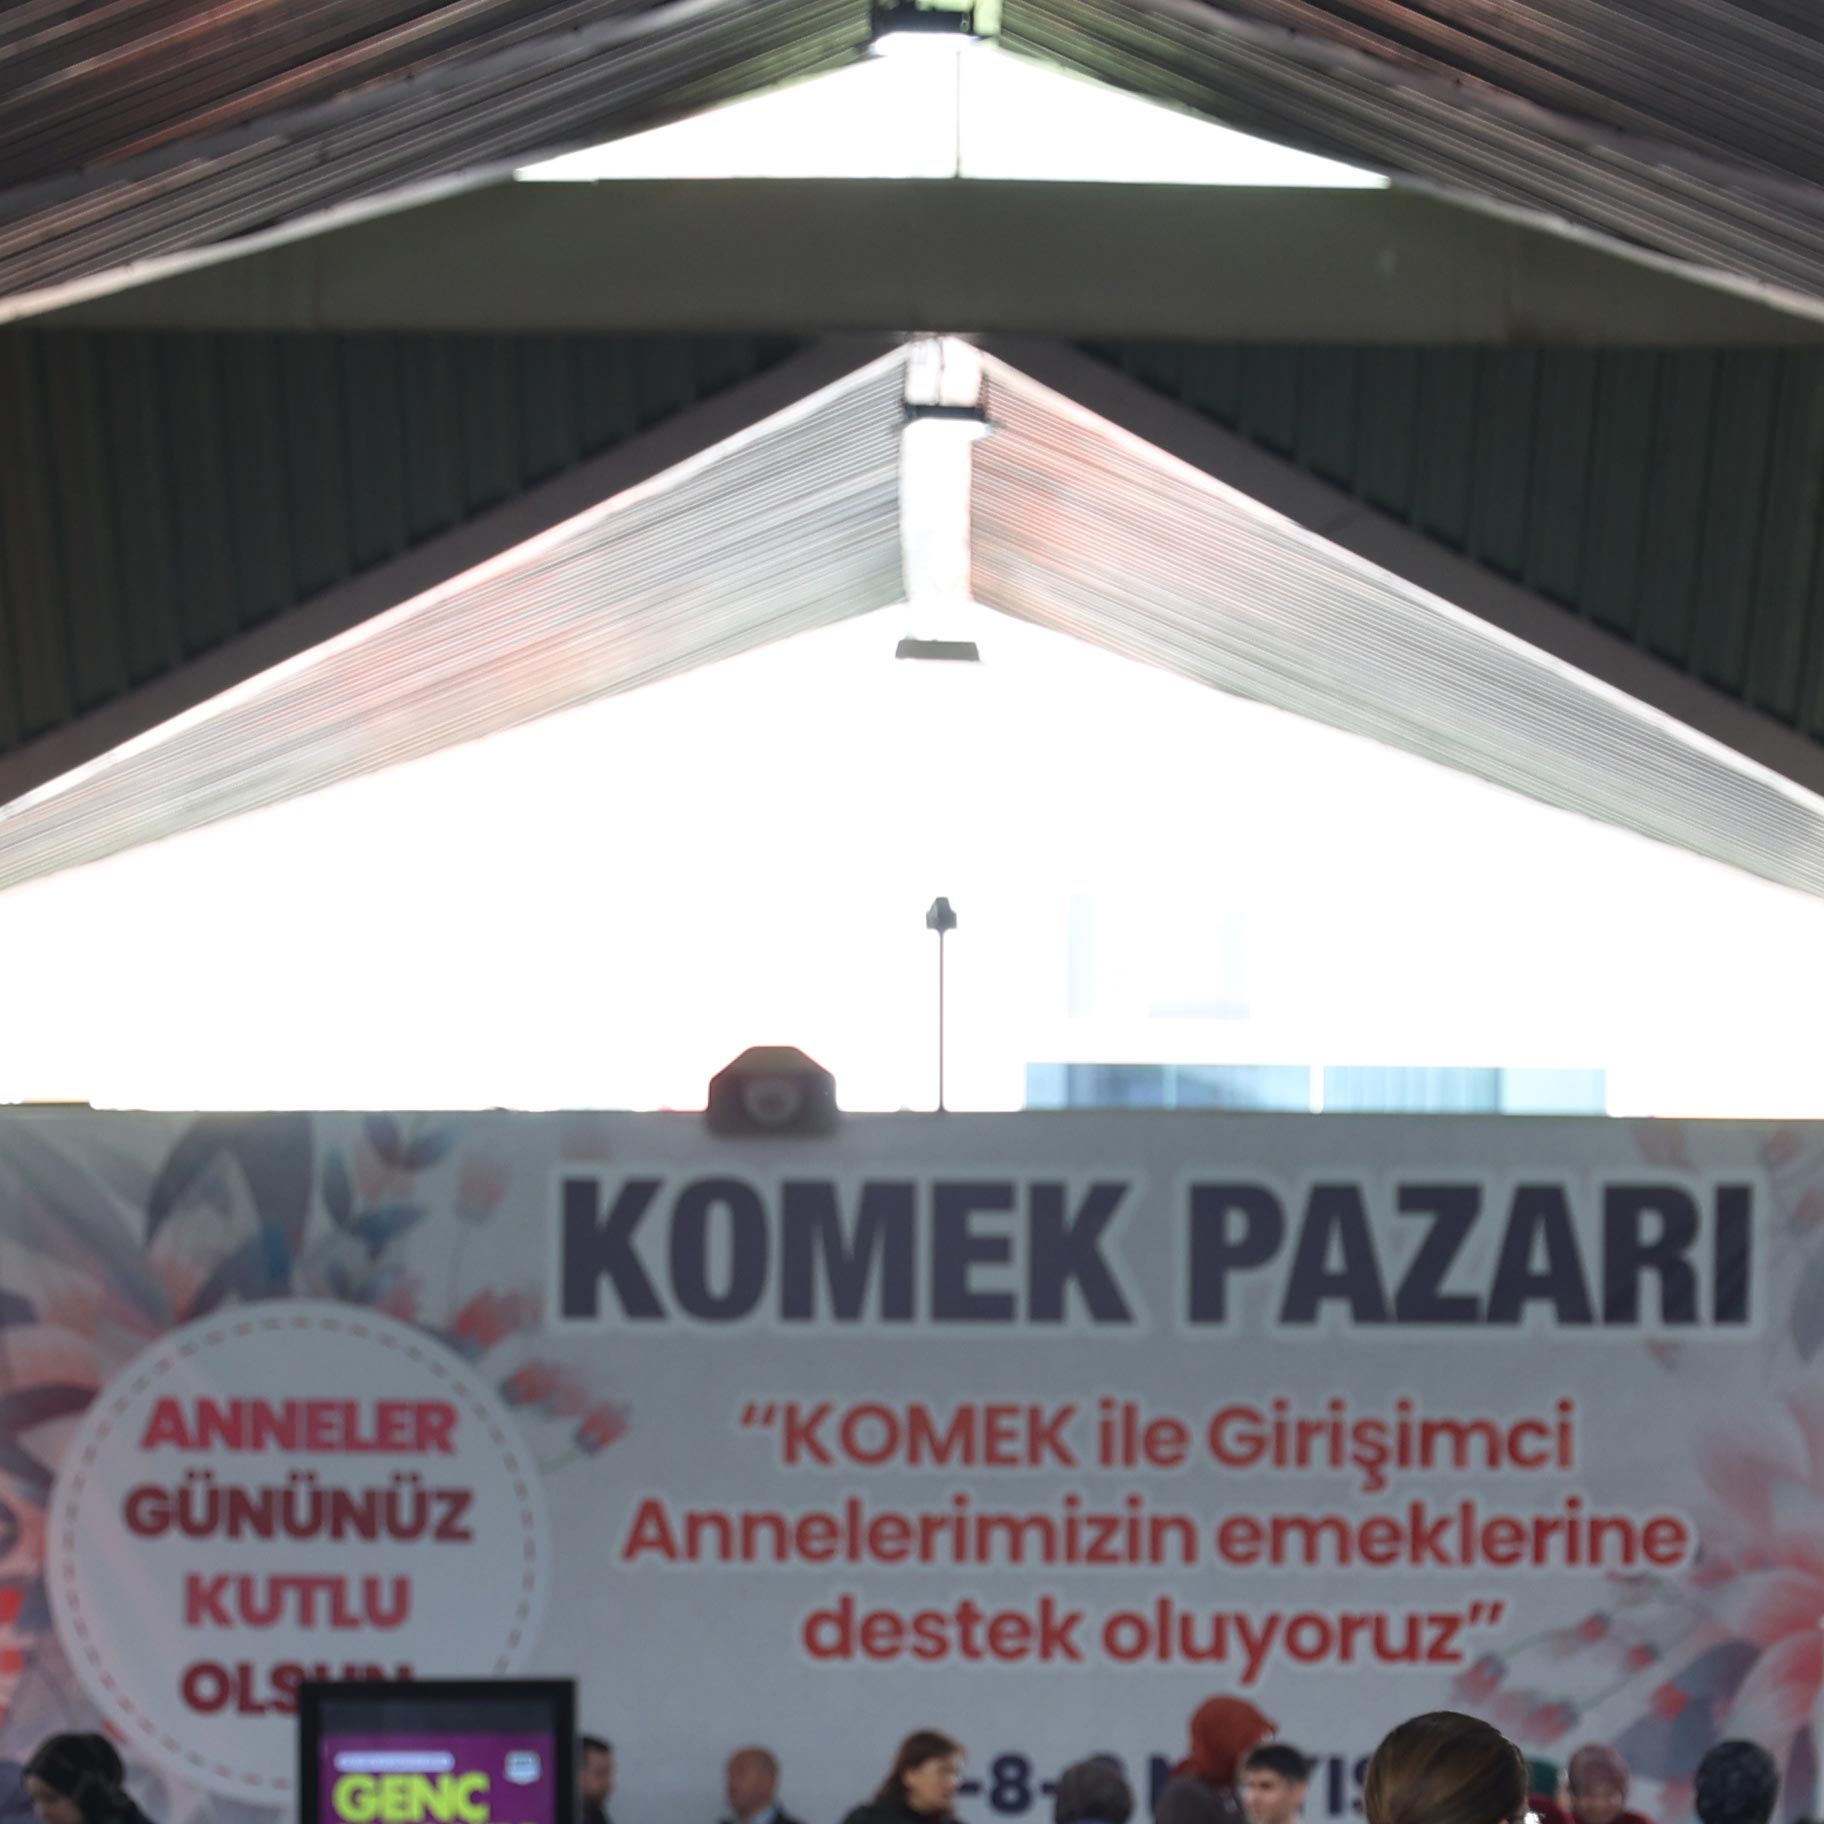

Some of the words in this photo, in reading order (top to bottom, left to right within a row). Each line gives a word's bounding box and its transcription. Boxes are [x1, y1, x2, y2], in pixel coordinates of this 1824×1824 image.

[560, 1176, 1134, 1326] KOMEK
[1187, 1181, 1754, 1327] PAZARI
[139, 1396, 458, 1454] ANNELER
[1096, 1395, 1190, 1468] ile
[1206, 1397, 1573, 1492] Girişimci
[122, 1468, 474, 1544] GÜNÜNÜZ
[620, 1492, 1197, 1564] Annelerimizin
[1215, 1494, 1691, 1566] emeklerine
[184, 1572, 412, 1629] KUTLU
[802, 1592, 1083, 1661] destek
